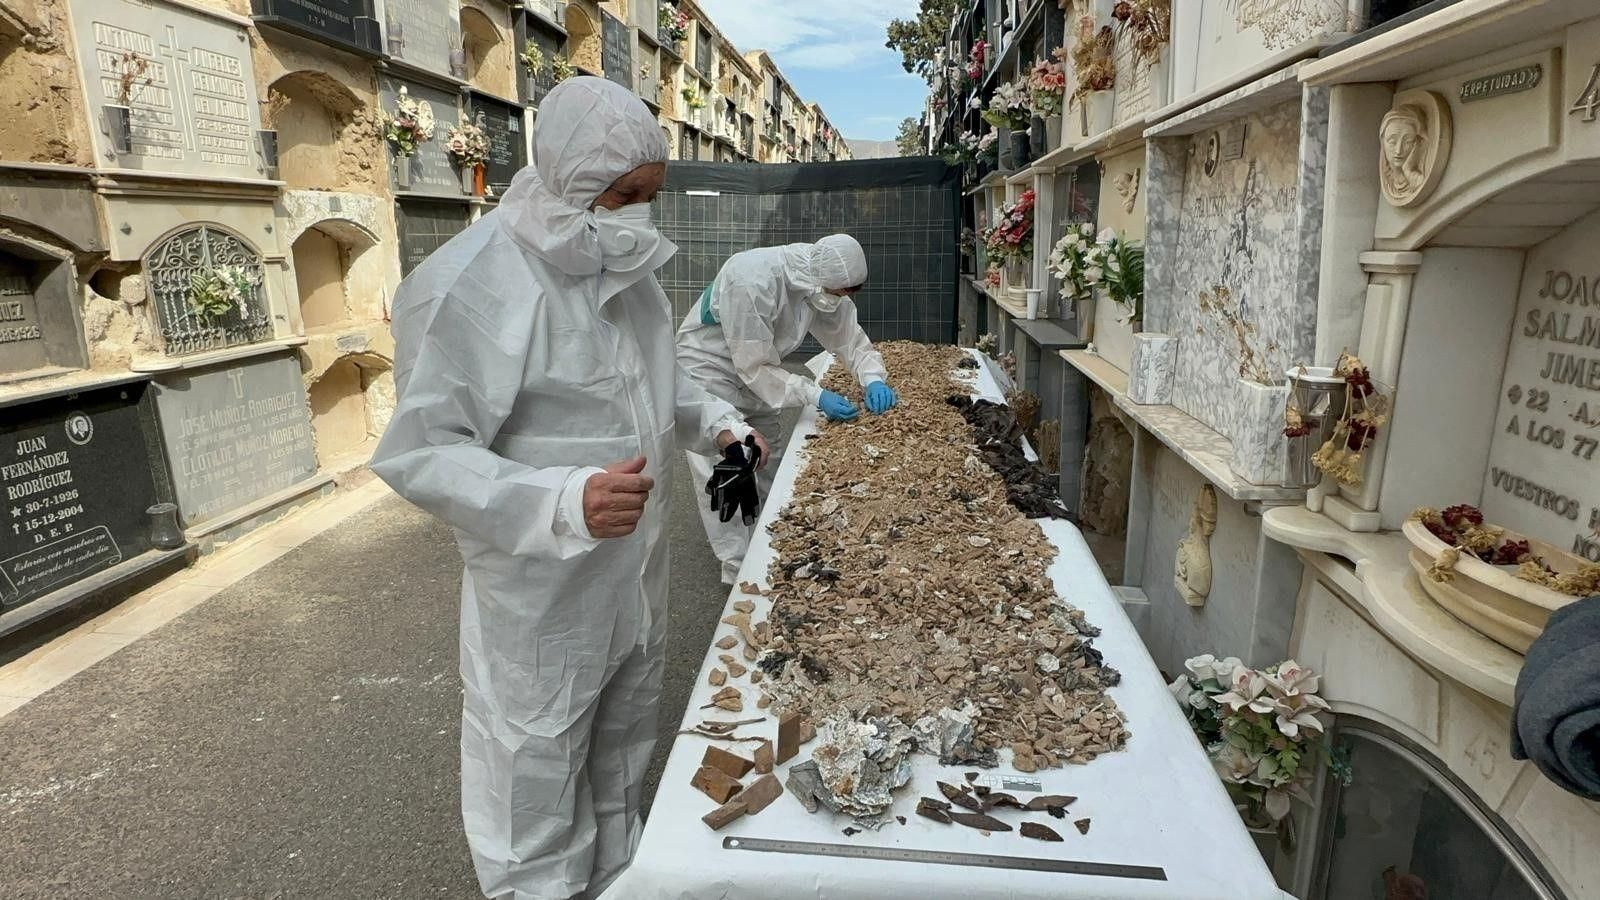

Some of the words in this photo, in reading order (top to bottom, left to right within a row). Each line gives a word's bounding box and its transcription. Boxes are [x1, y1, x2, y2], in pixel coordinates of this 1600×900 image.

[1460, 71, 1526, 97] PERPETUIDAD
[16, 436, 47, 456] JUAN
[1505, 415, 1519, 435] A
[1526, 421, 1566, 449] LOS
[1572, 435, 1598, 460] 77
[1, 451, 69, 480] FERNÁNDEZ
[7, 469, 73, 500] RODRÍGUEZ
[1491, 467, 1580, 520] VUESTROS
[25, 489, 79, 514] 30-7-1926
[25, 503, 84, 531] 15-12-2004
[34, 534, 46, 544] D.
[50, 528, 61, 538] E.
[65, 523, 74, 533] P.
[47, 550, 62, 560] con
[16, 575, 26, 586] el
[27, 563, 62, 582] recuerdo
